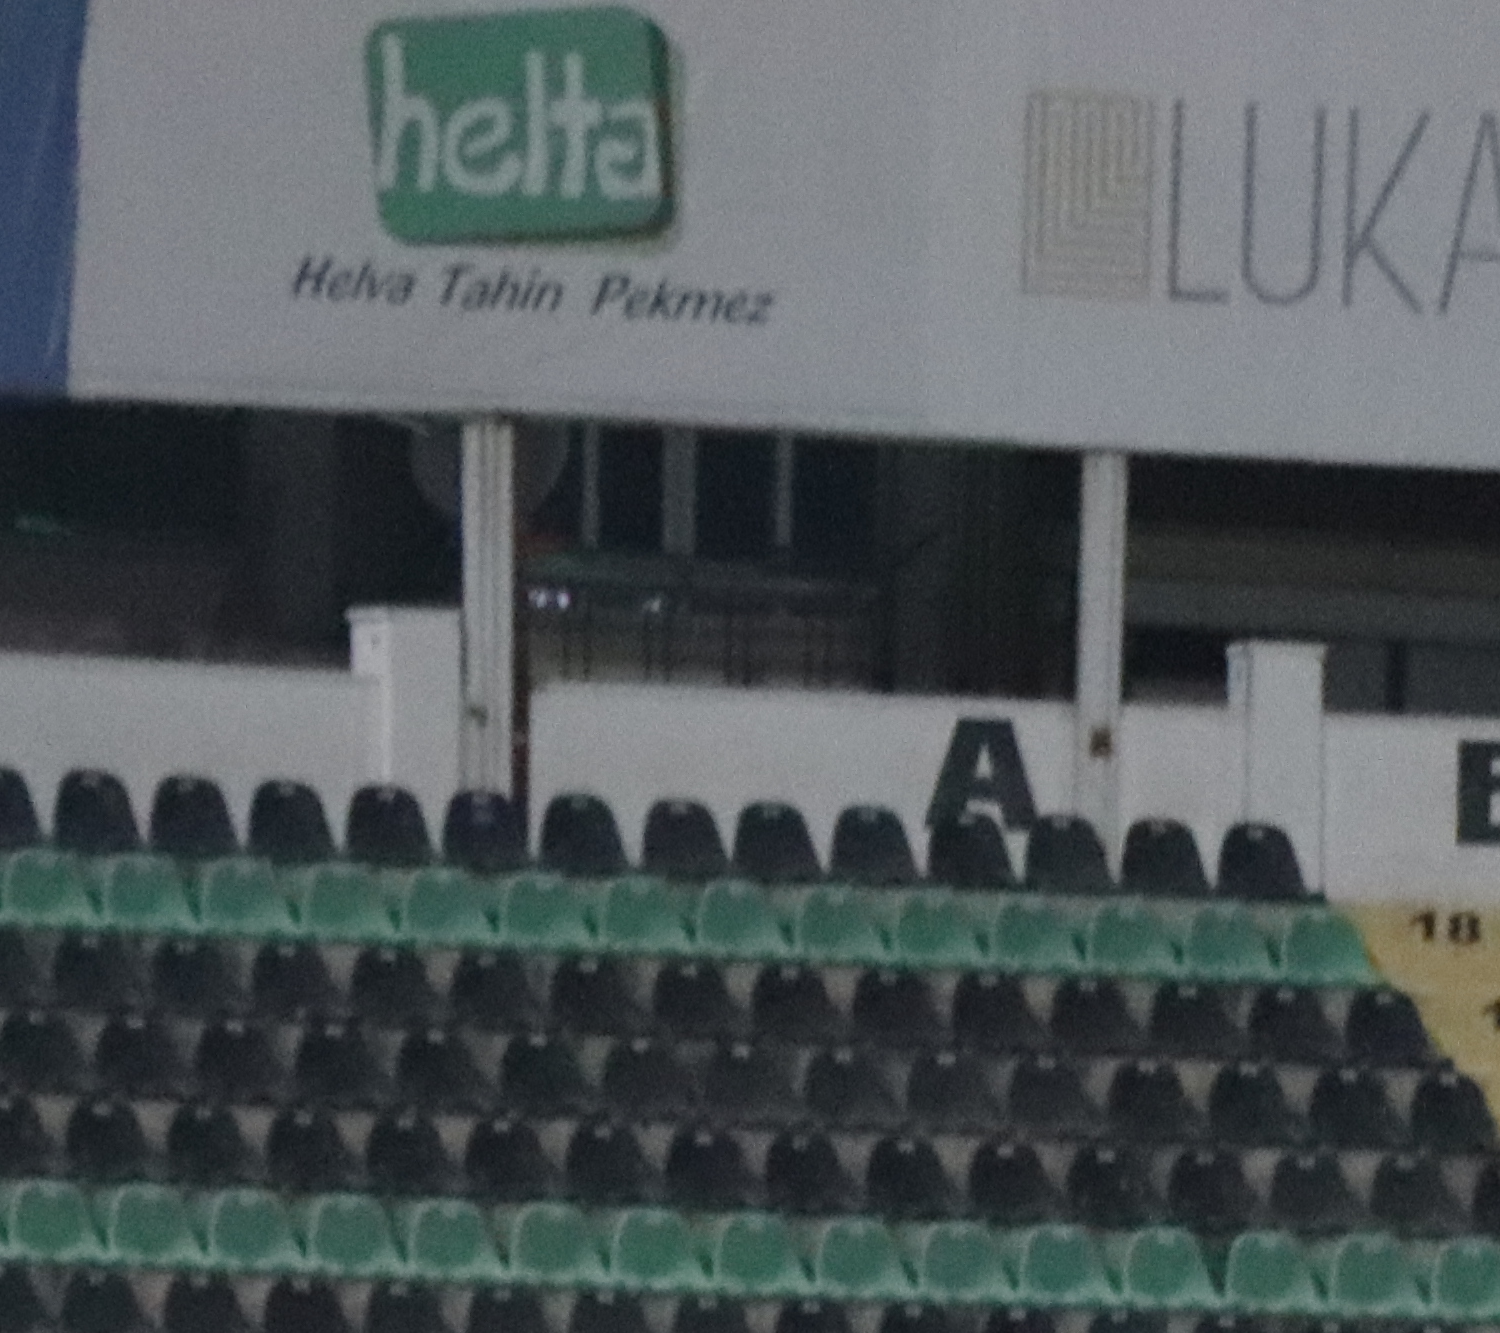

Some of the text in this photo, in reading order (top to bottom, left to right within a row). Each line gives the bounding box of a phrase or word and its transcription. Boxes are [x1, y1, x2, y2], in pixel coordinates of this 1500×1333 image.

[372, 36, 660, 200] helta
[290, 254, 776, 327] Helva Tahin Pekmez
[925, 716, 1041, 832] A
[1409, 908, 1484, 947] 18
